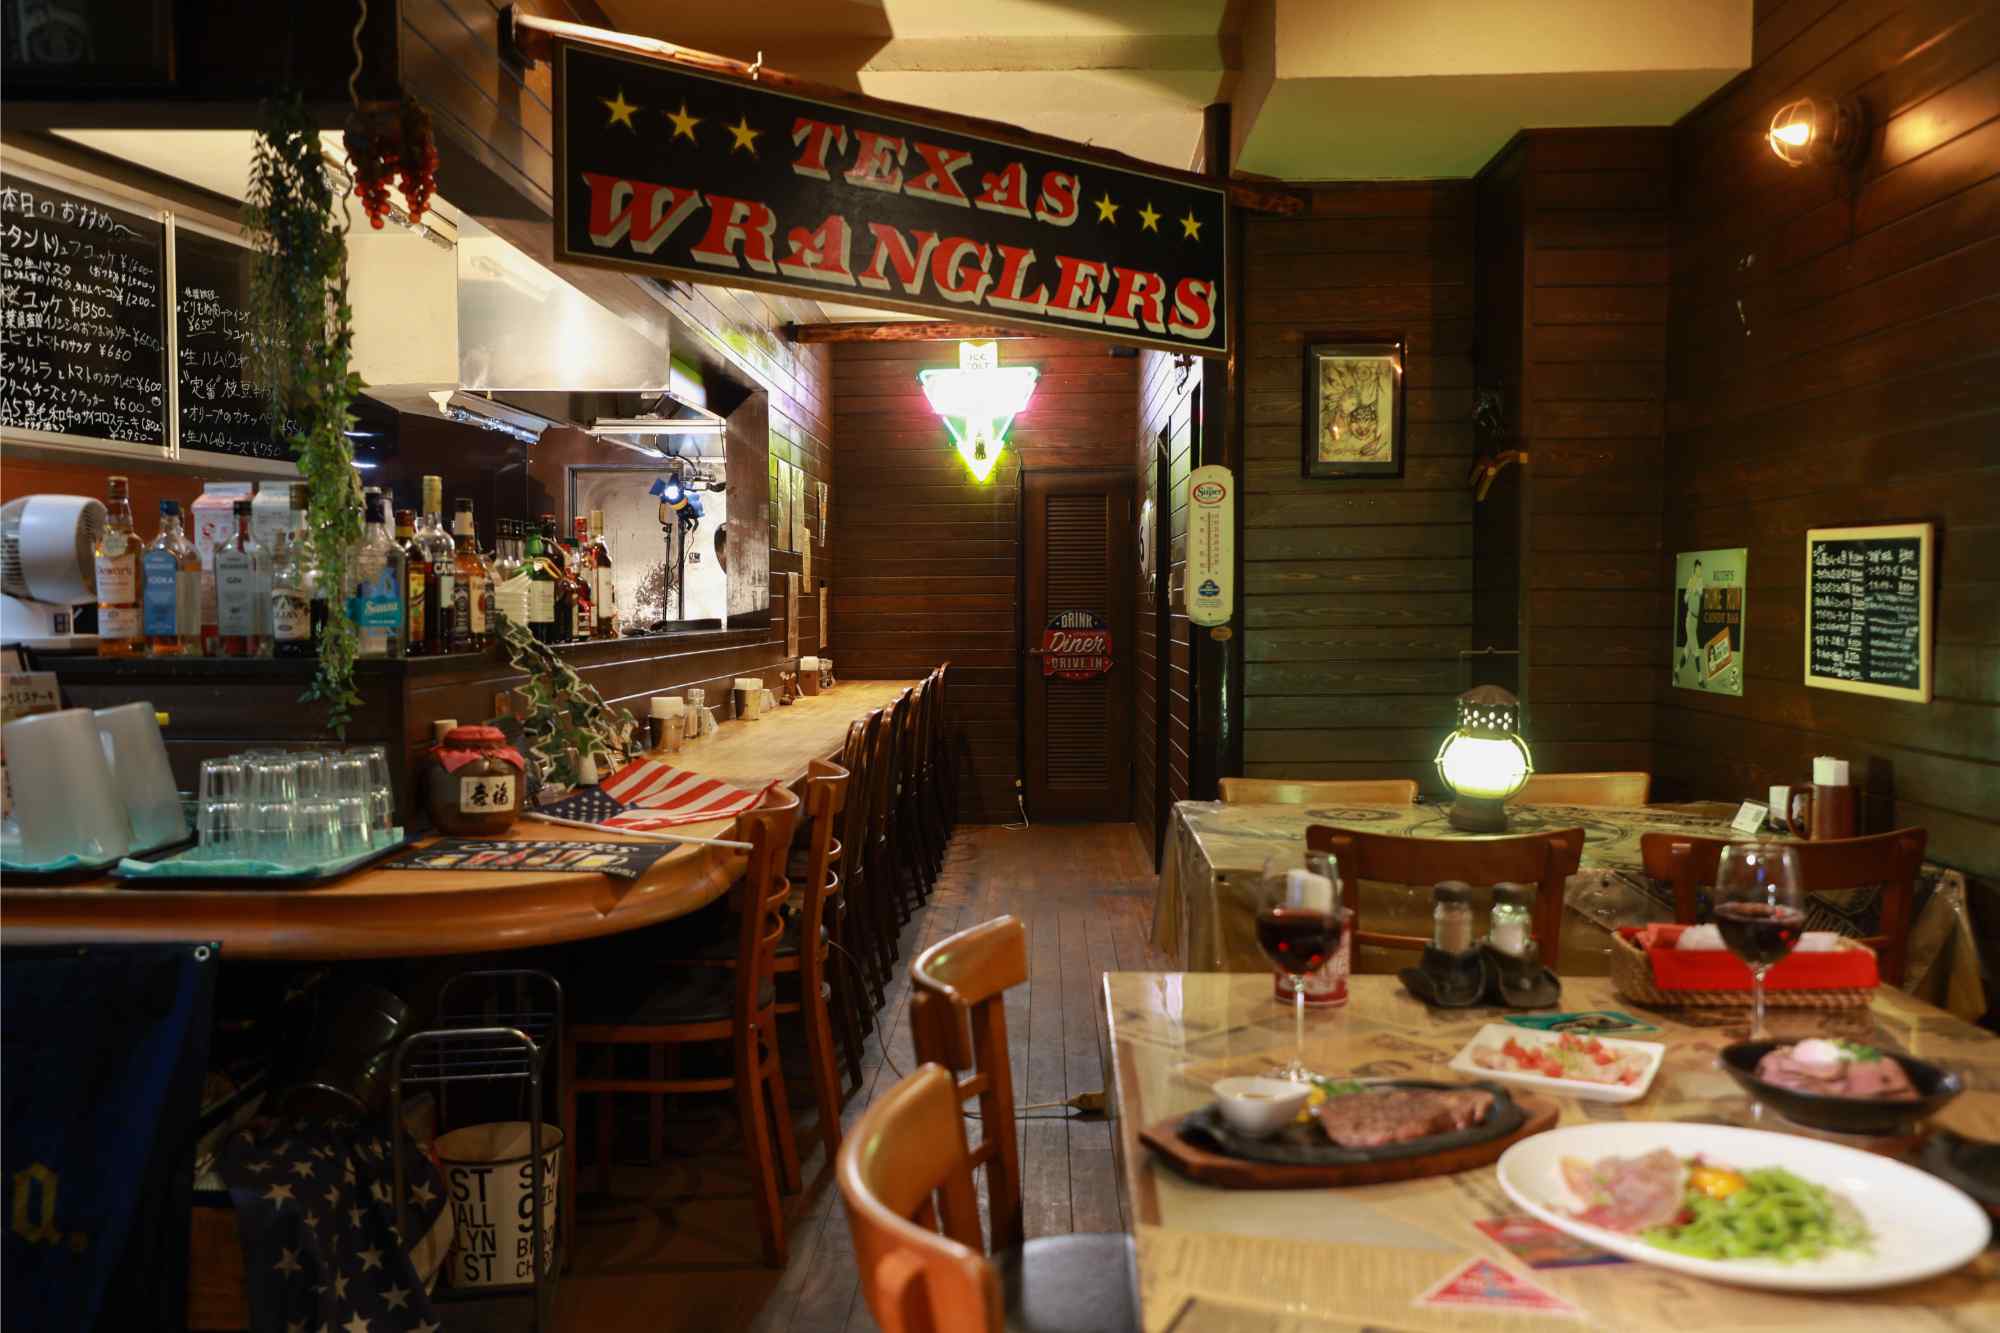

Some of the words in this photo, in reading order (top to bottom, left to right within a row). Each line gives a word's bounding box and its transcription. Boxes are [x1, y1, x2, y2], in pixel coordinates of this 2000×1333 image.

[791, 117, 1081, 227] TEXAS
[582, 171, 1216, 339] WRANGLERS
[1048, 631, 1106, 653] Diner
[449, 1167, 494, 1203] ST
[464, 1253, 497, 1282] ST
